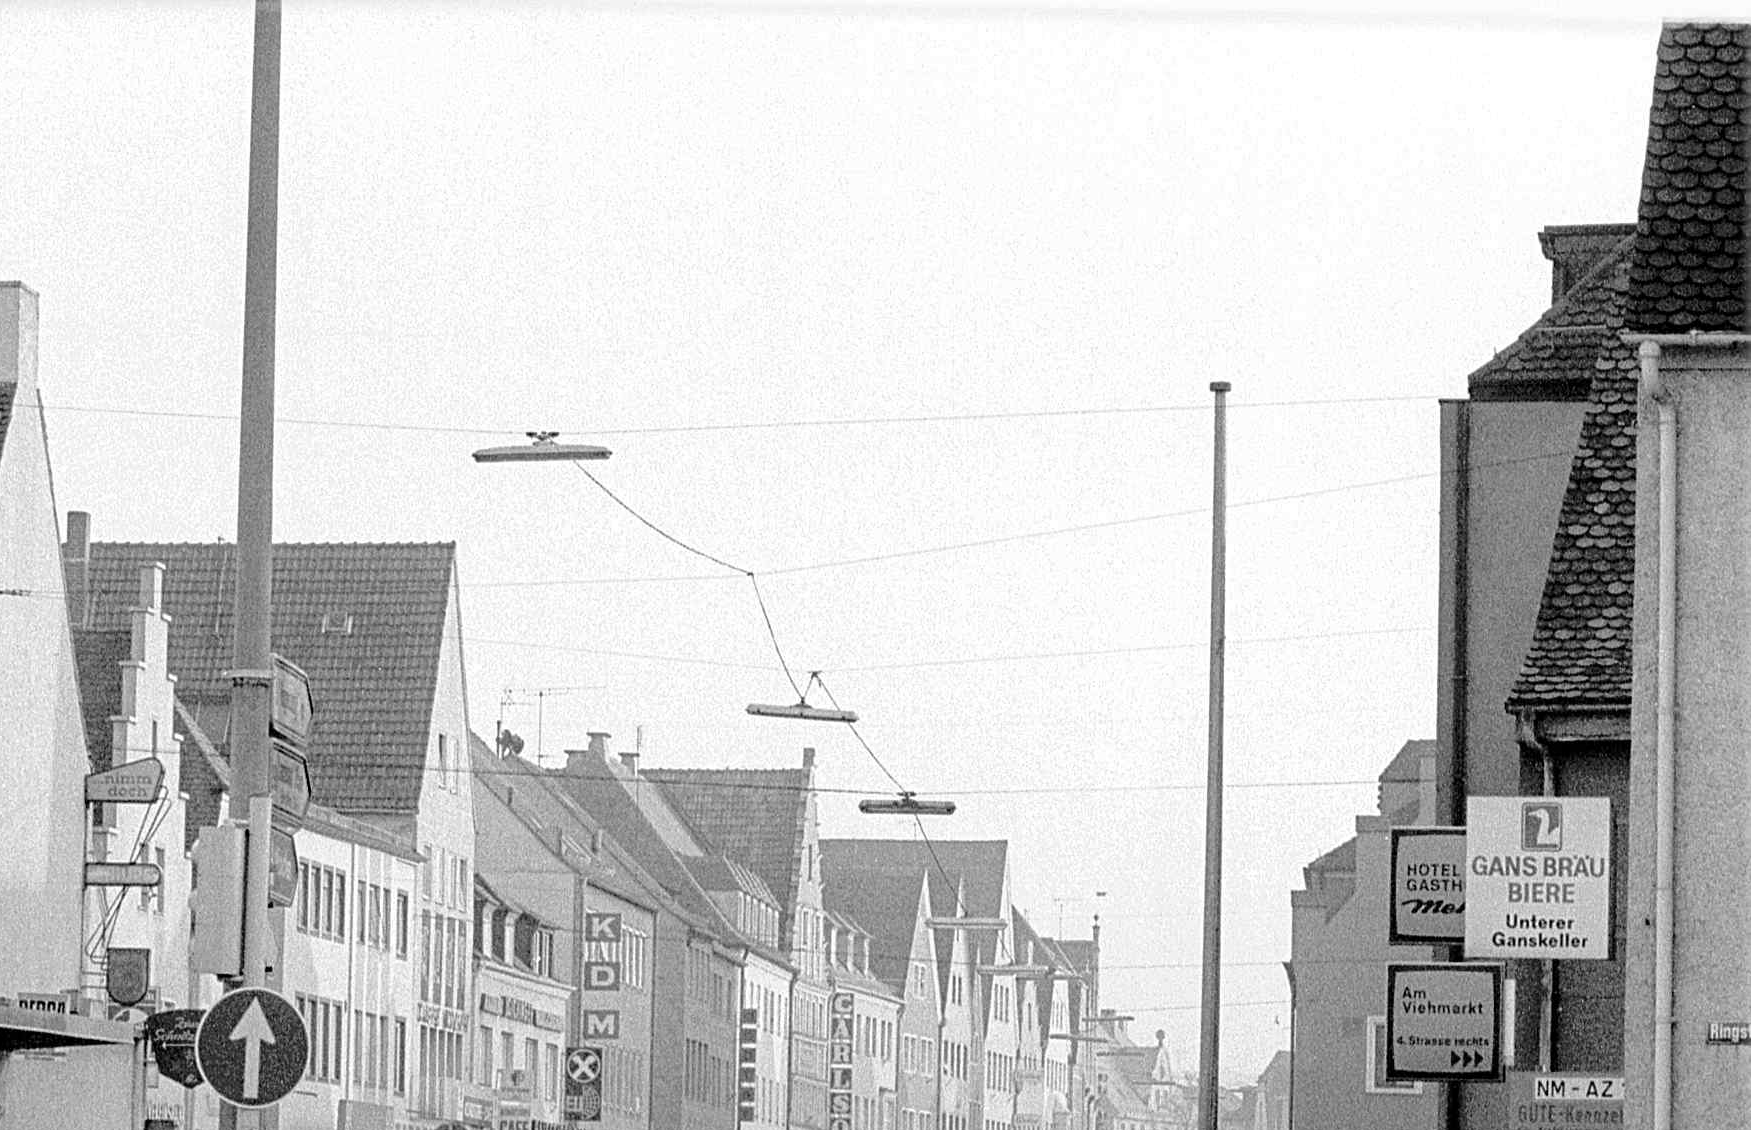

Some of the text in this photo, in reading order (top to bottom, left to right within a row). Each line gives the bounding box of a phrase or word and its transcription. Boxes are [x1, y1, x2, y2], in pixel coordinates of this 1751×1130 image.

[107, 787, 147, 798] doch
[1406, 863, 1461, 878] HOTEL
[1471, 854, 1605, 878] GANS BRÄU
[1507, 882, 1576, 904] BIERE
[1505, 913, 1575, 930] Unterer
[1491, 931, 1589, 949] Ganskeller
[1402, 986, 1427, 999] Am
[1402, 1001, 1483, 1015] Viehmarkt
[1454, 1036, 1489, 1047] rechts
[1536, 1080, 1566, 1098] NM
[1586, 1080, 1614, 1098] AZ
